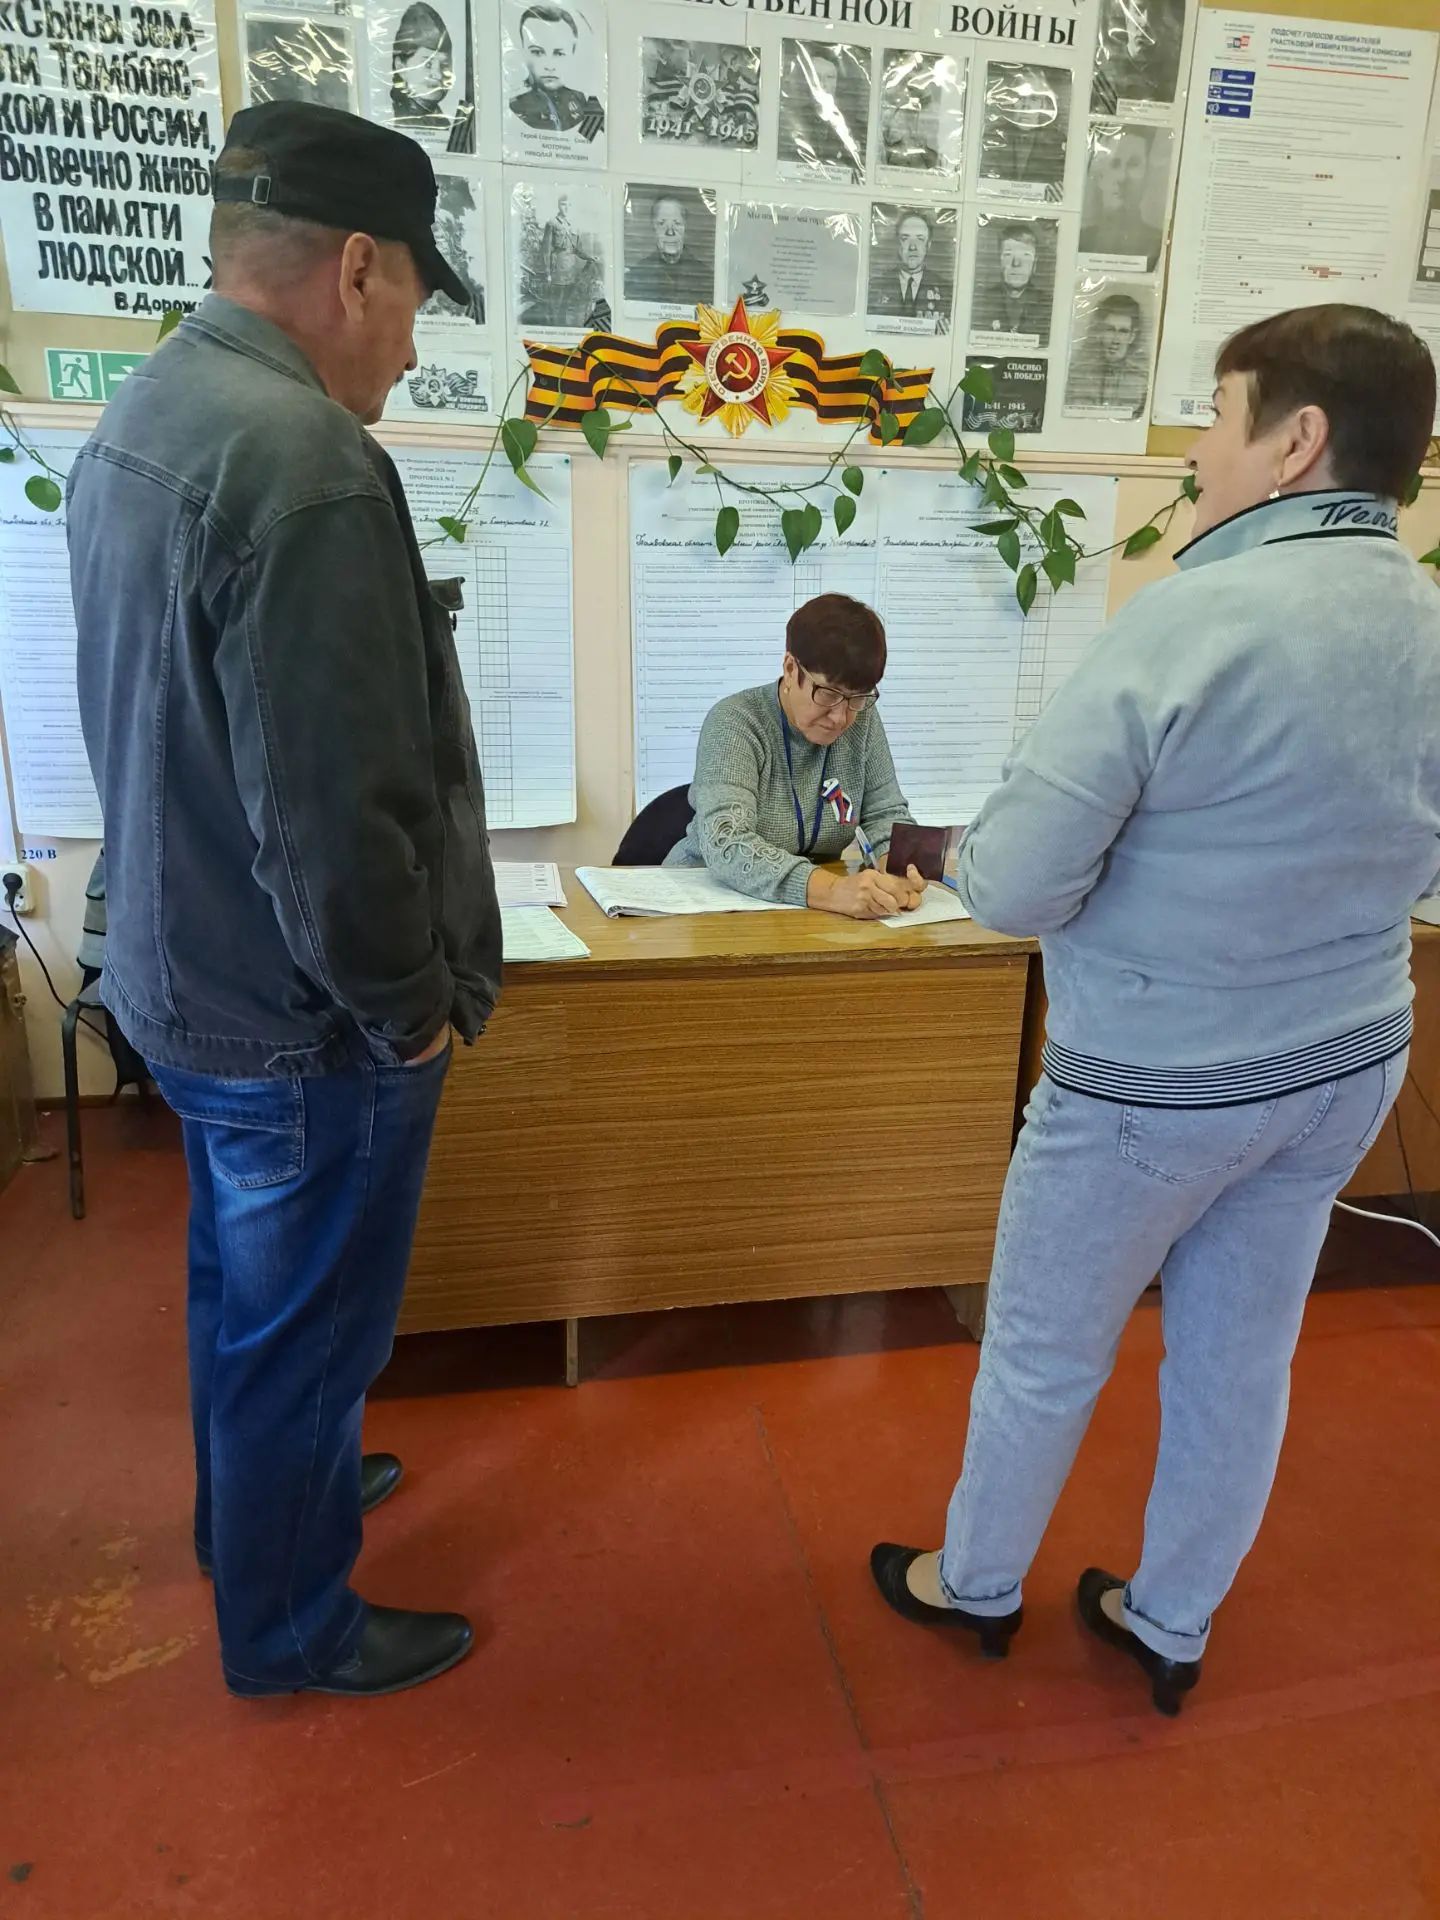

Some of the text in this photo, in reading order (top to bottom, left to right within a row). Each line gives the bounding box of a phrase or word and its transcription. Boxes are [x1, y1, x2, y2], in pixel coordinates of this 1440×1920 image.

[951, 4, 1077, 46] ВОЙНЫ
[648, 117, 691, 138] 1941
[709, 116, 756, 143] 1945
[59, 194, 182, 241] памяти
[708, 335, 768, 396] ОТЕЧЕСТВЕННАЯ ВОЙНА
[1007, 363, 1042, 371] СПАСИБО
[1008, 402, 1026, 410] 1945
[21, 849, 43, 859] 220
